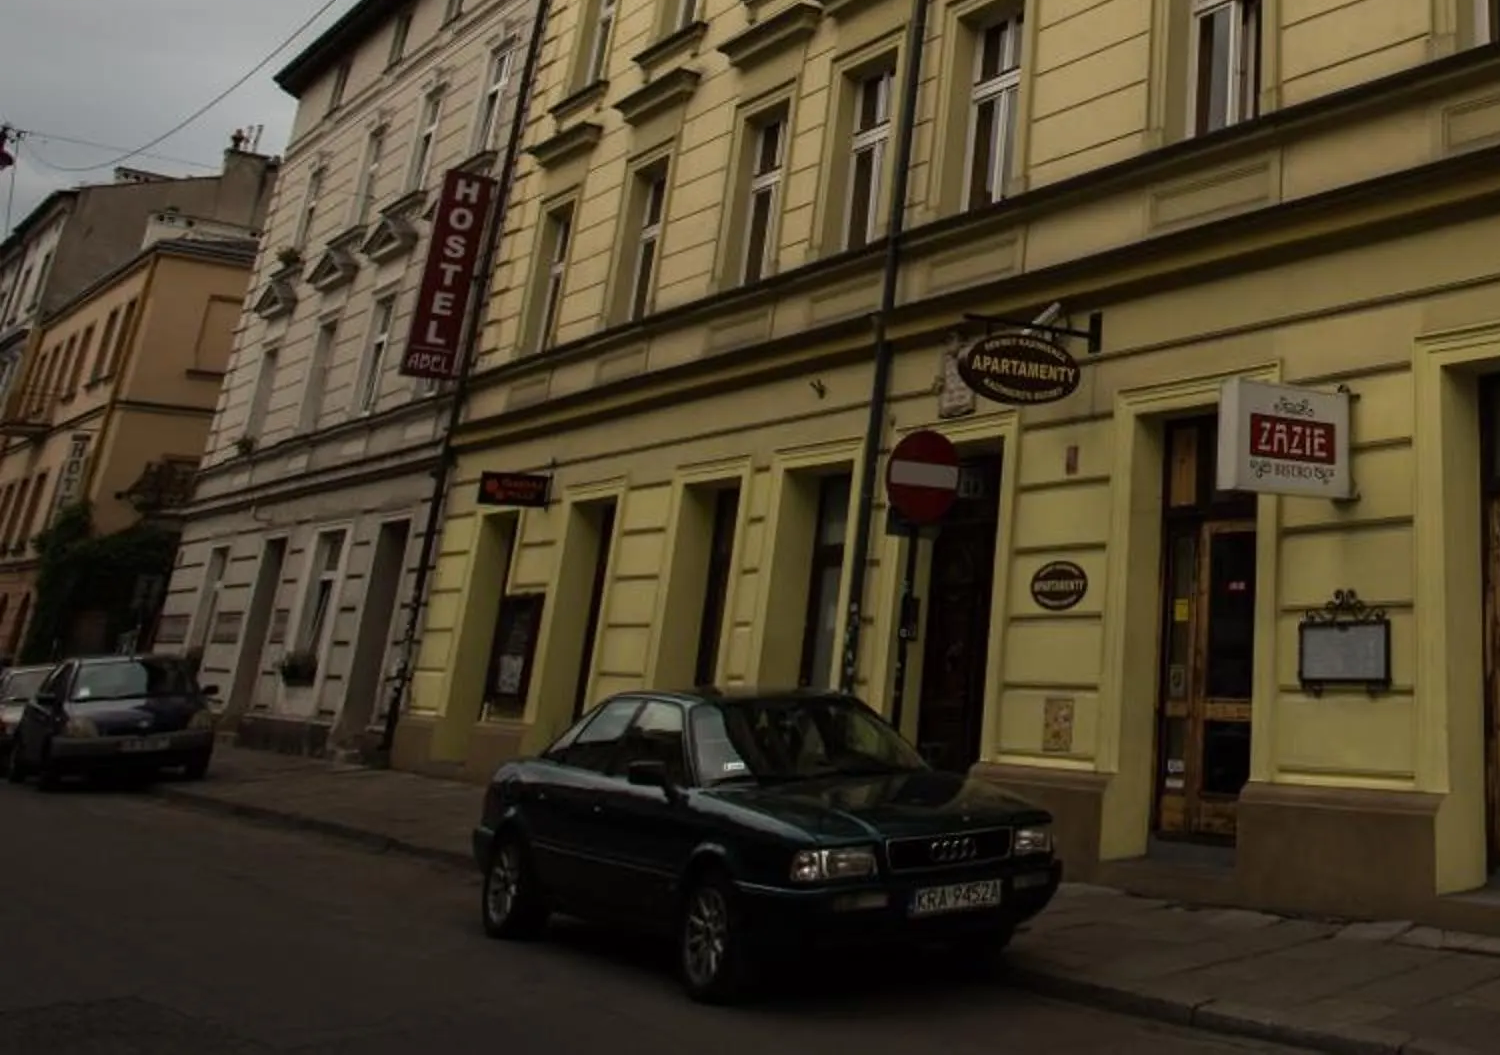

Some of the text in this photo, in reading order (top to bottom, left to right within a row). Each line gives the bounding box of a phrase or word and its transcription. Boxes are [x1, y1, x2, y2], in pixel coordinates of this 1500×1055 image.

[424, 177, 481, 345] HOSTEL
[971, 354, 1076, 384] APARTAMENTY
[1257, 421, 1328, 458] ZAZIE
